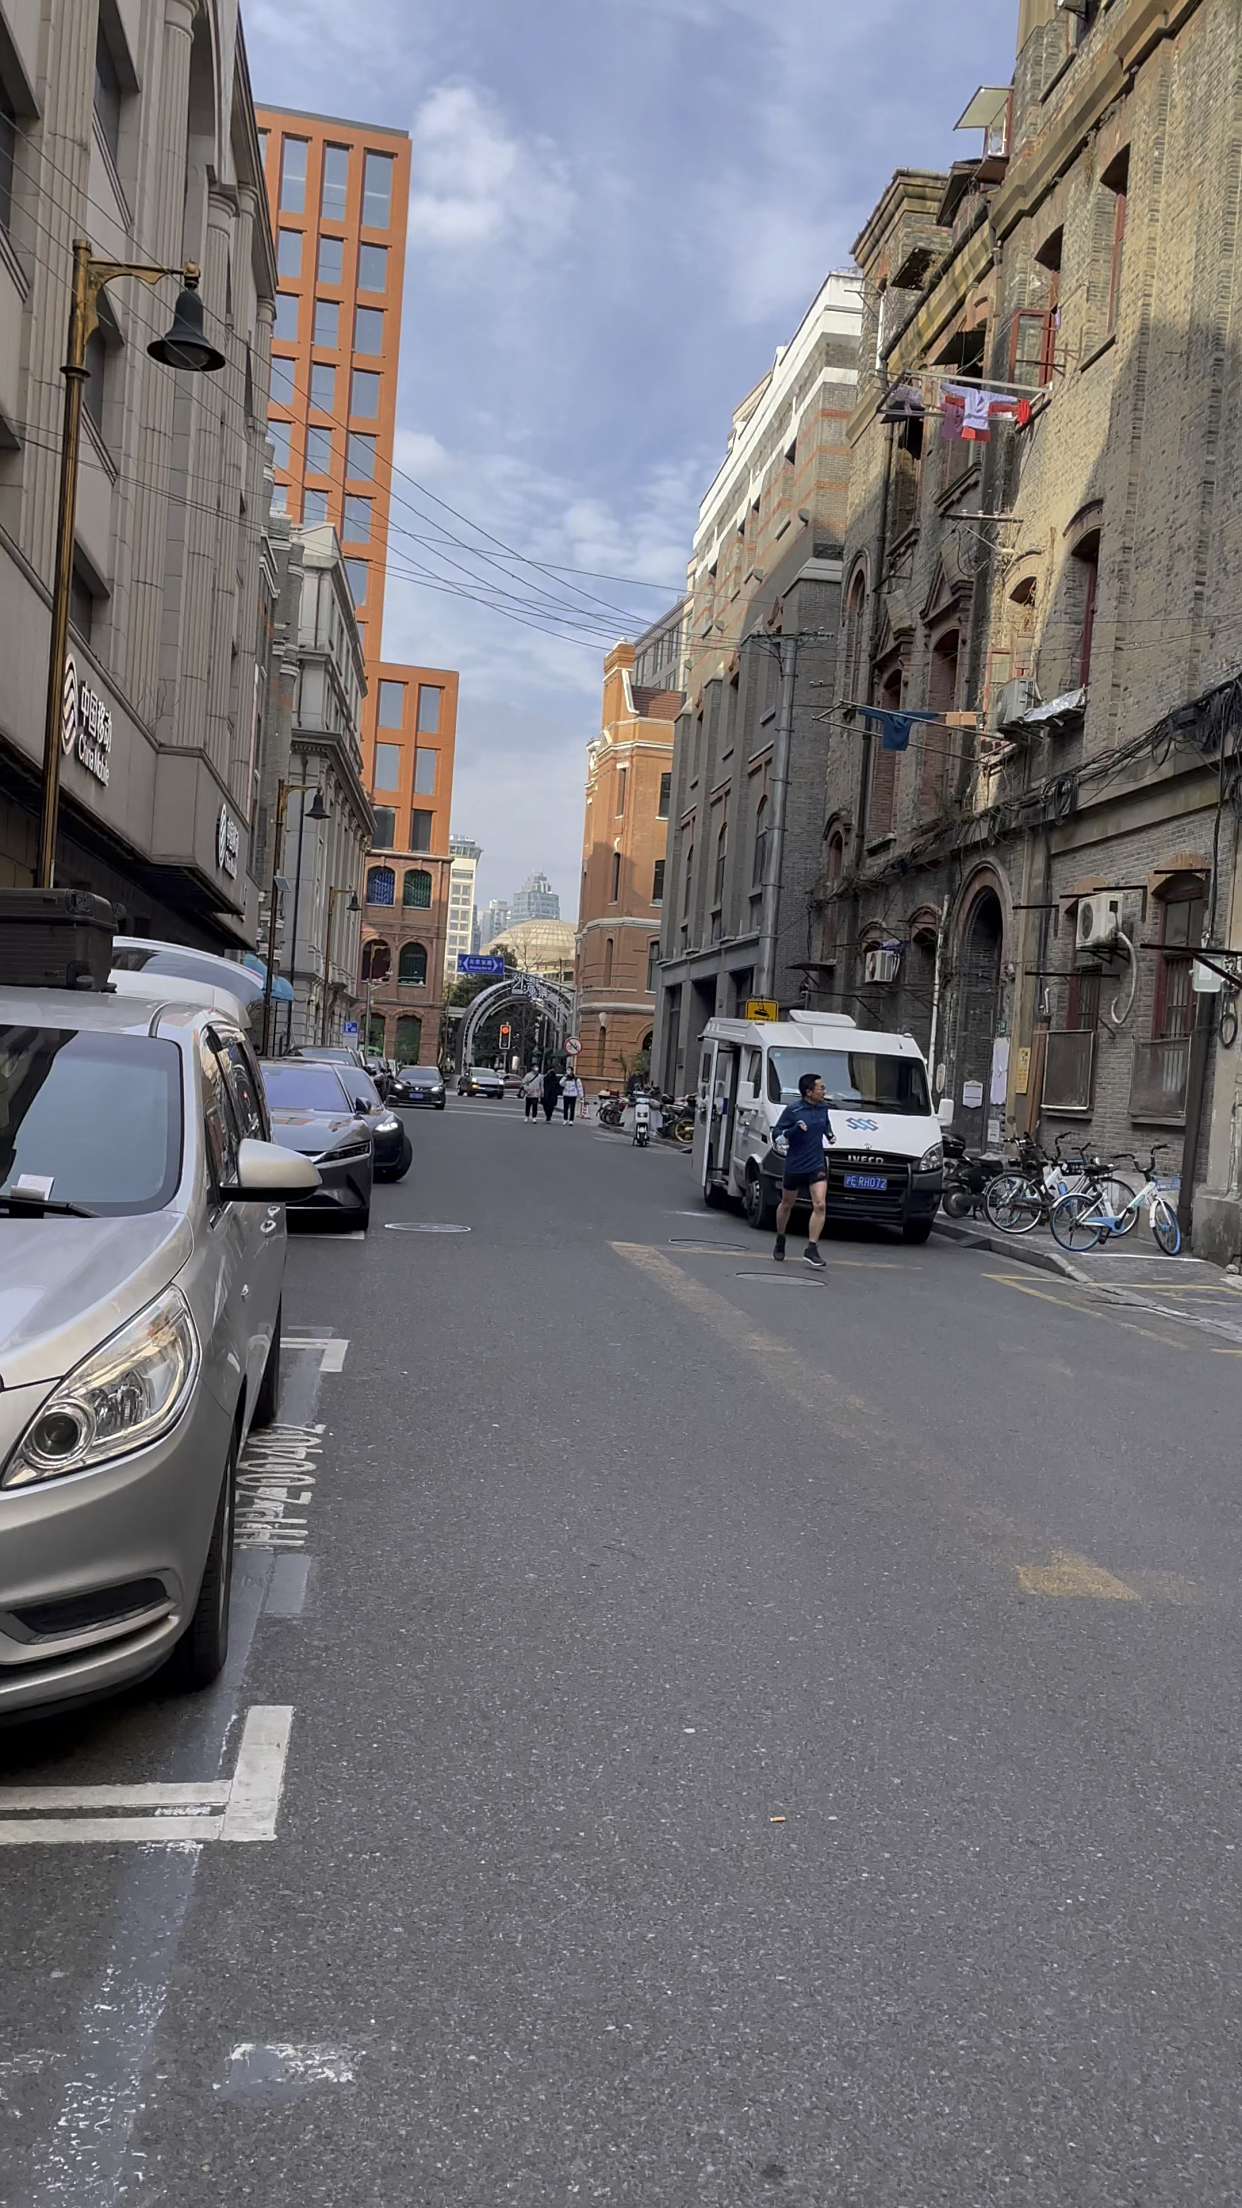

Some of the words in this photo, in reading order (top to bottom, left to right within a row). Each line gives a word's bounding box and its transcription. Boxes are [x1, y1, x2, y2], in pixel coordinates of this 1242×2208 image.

[81, 681, 112, 753] 中国移动
[79, 733, 95, 770] China
[345, 1022, 352, 1032] P
[846, 1155, 884, 1164] IVECO
